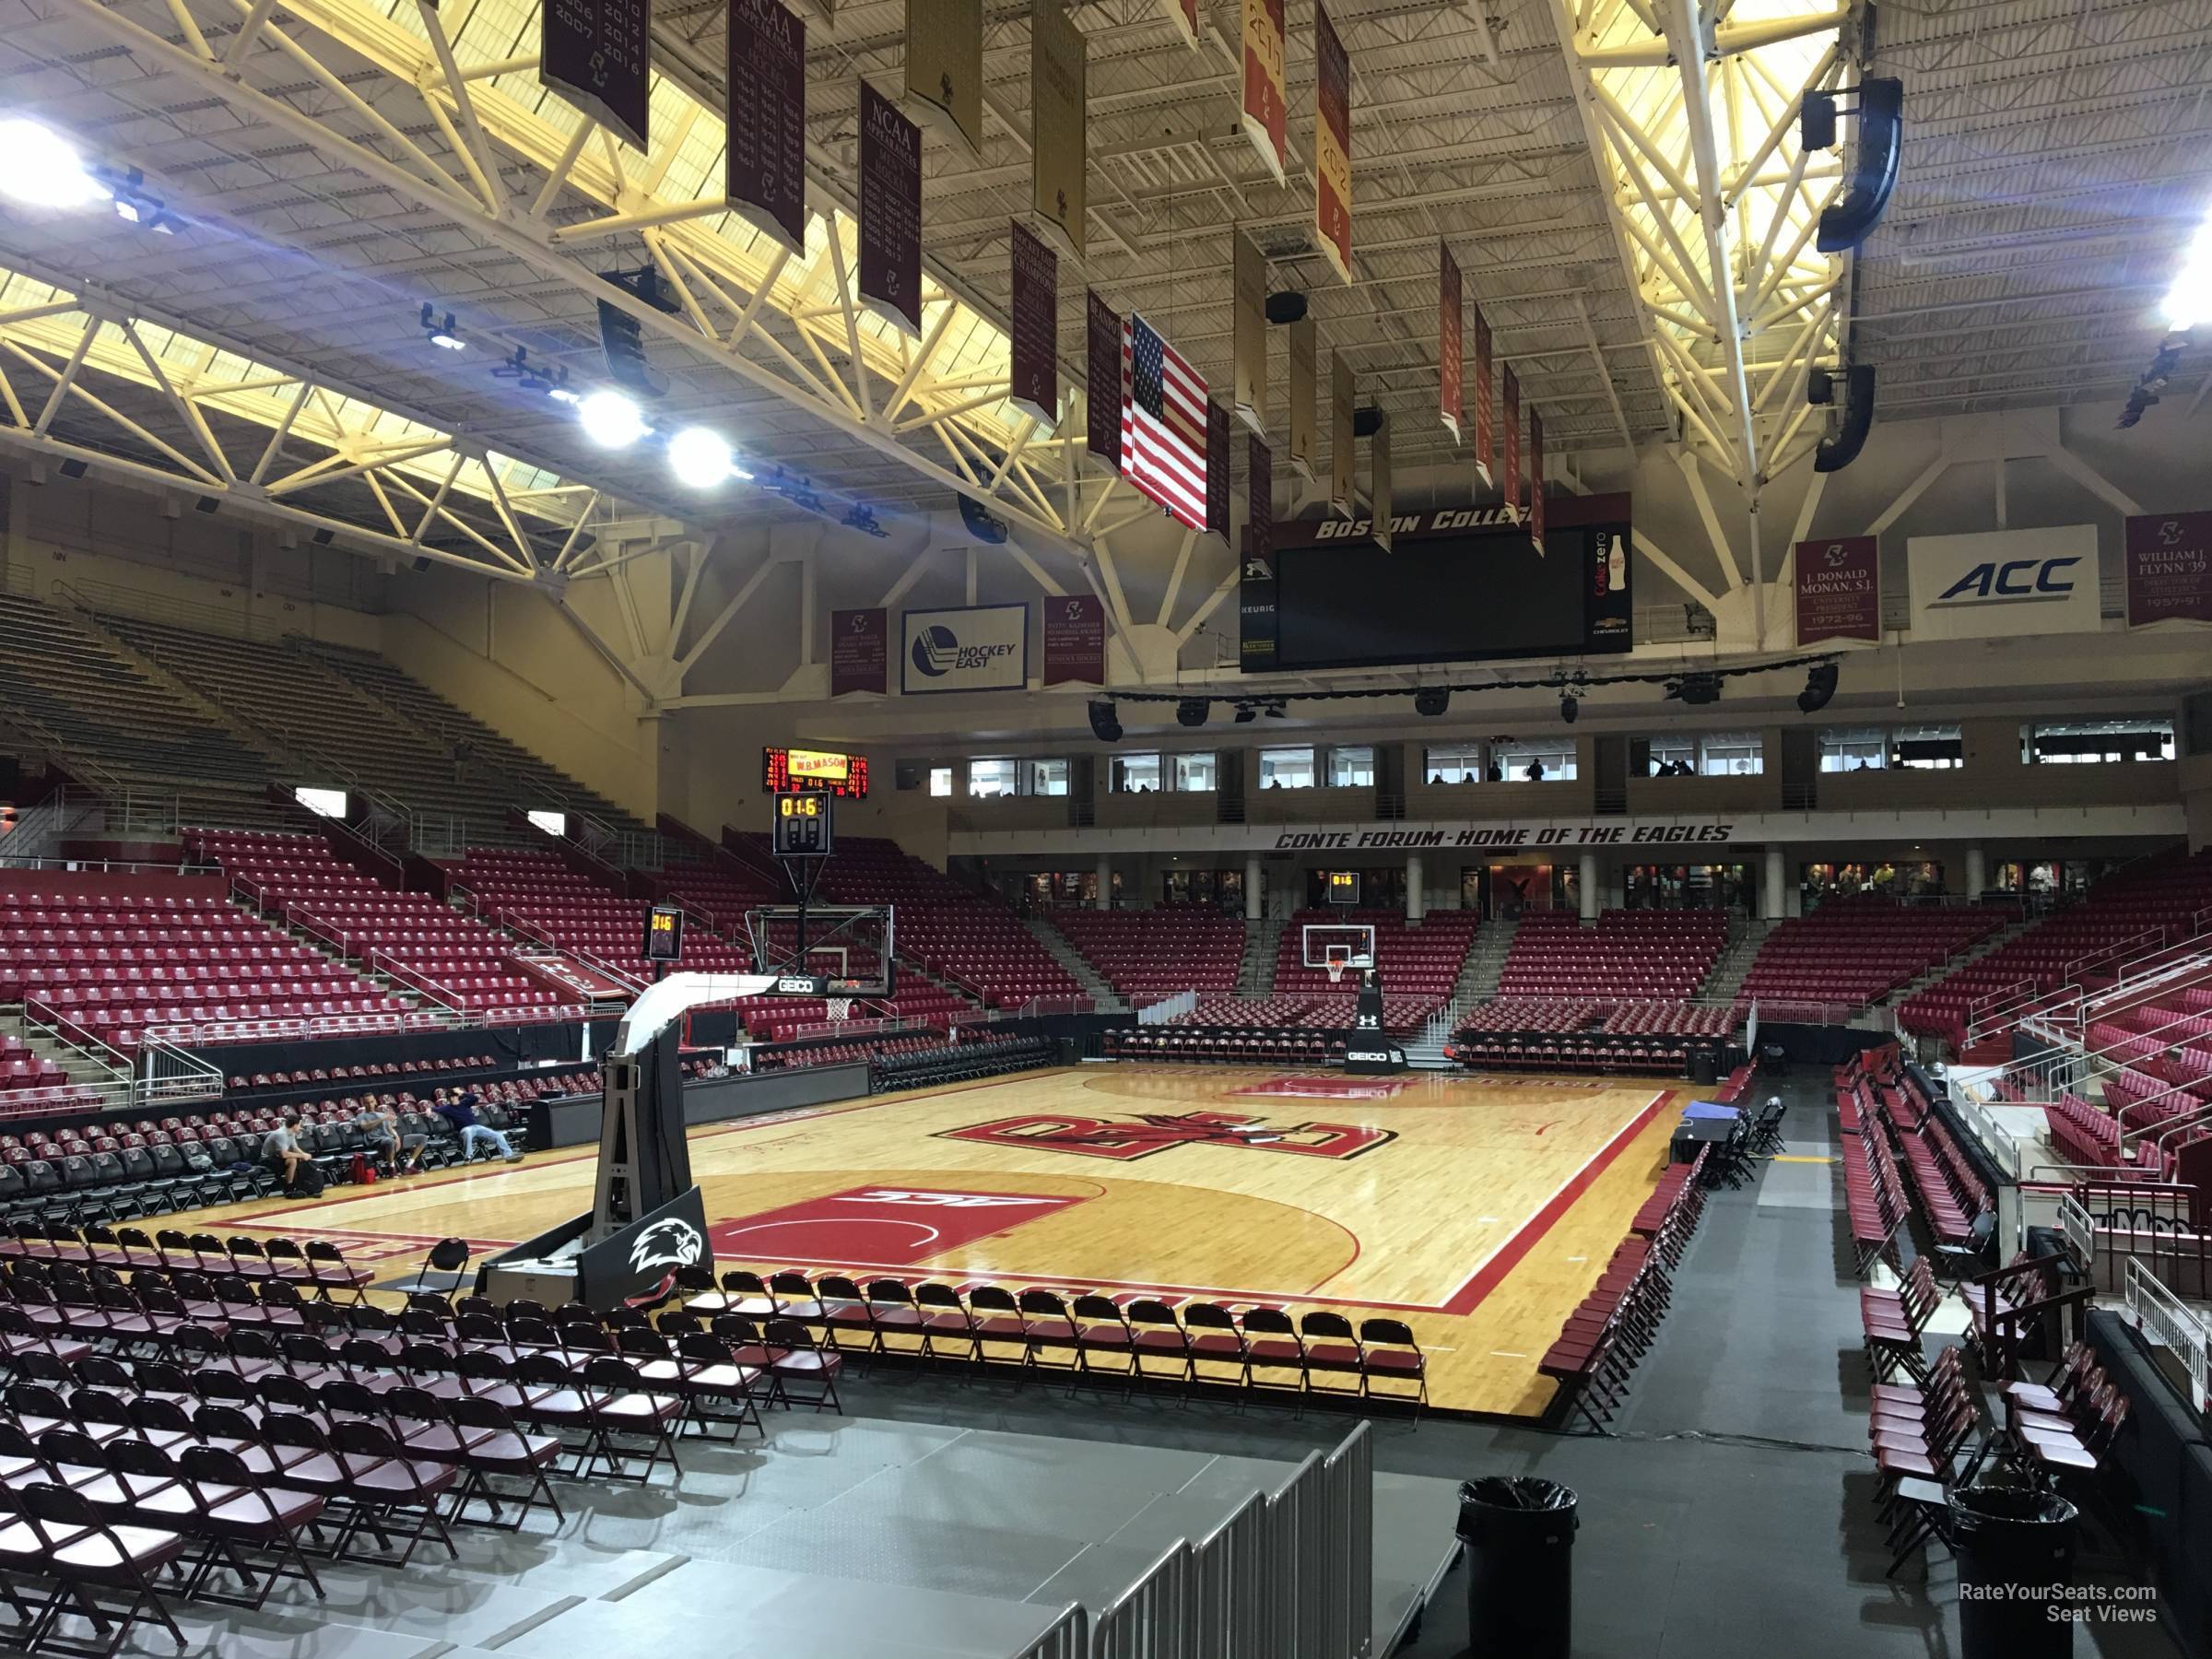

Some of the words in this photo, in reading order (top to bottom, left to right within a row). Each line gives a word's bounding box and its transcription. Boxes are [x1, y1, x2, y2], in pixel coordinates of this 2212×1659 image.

[555, 4, 594, 40] 2007
[604, 3, 641, 37] 2012
[604, 22, 641, 56] 2014
[604, 42, 641, 76] 2016
[872, 98, 912, 152] NCAA
[1323, 135, 1347, 192] 2012
[1014, 229, 1039, 254] HOCKEY
[1041, 250, 1055, 269] EAST
[1014, 253, 1055, 293] CHAMPIONS
[1089, 298, 1120, 335] BEANPOT
[1315, 516, 1420, 539] BOSON
[1595, 532, 1606, 564] zero
[2137, 551, 2194, 562] WILLIAM
[1817, 569, 1866, 582] DONALD
[1937, 557, 2084, 599] ACC
[2138, 562, 2183, 575] FLYNN
[2188, 560, 2206, 573] '39
[1855, 579, 1874, 591] S.J.
[1241, 605, 1275, 613] KEURIG
[2147, 596, 2201, 607] 1957-91
[1812, 613, 1864, 625] 1972-96
[955, 657, 990, 669] EAST
[958, 644, 1016, 658] HOCKEY
[1275, 832, 1352, 849] CONTE
[1357, 830, 1445, 847] FORUM
[1455, 829, 1530, 845] HOME
[1535, 828, 1572, 843] OF
[1578, 827, 1625, 842] THE
[1631, 824, 1733, 841] EAGLES
[779, 979, 813, 994] GEICO
[1347, 1052, 1387, 1062] GEICO
